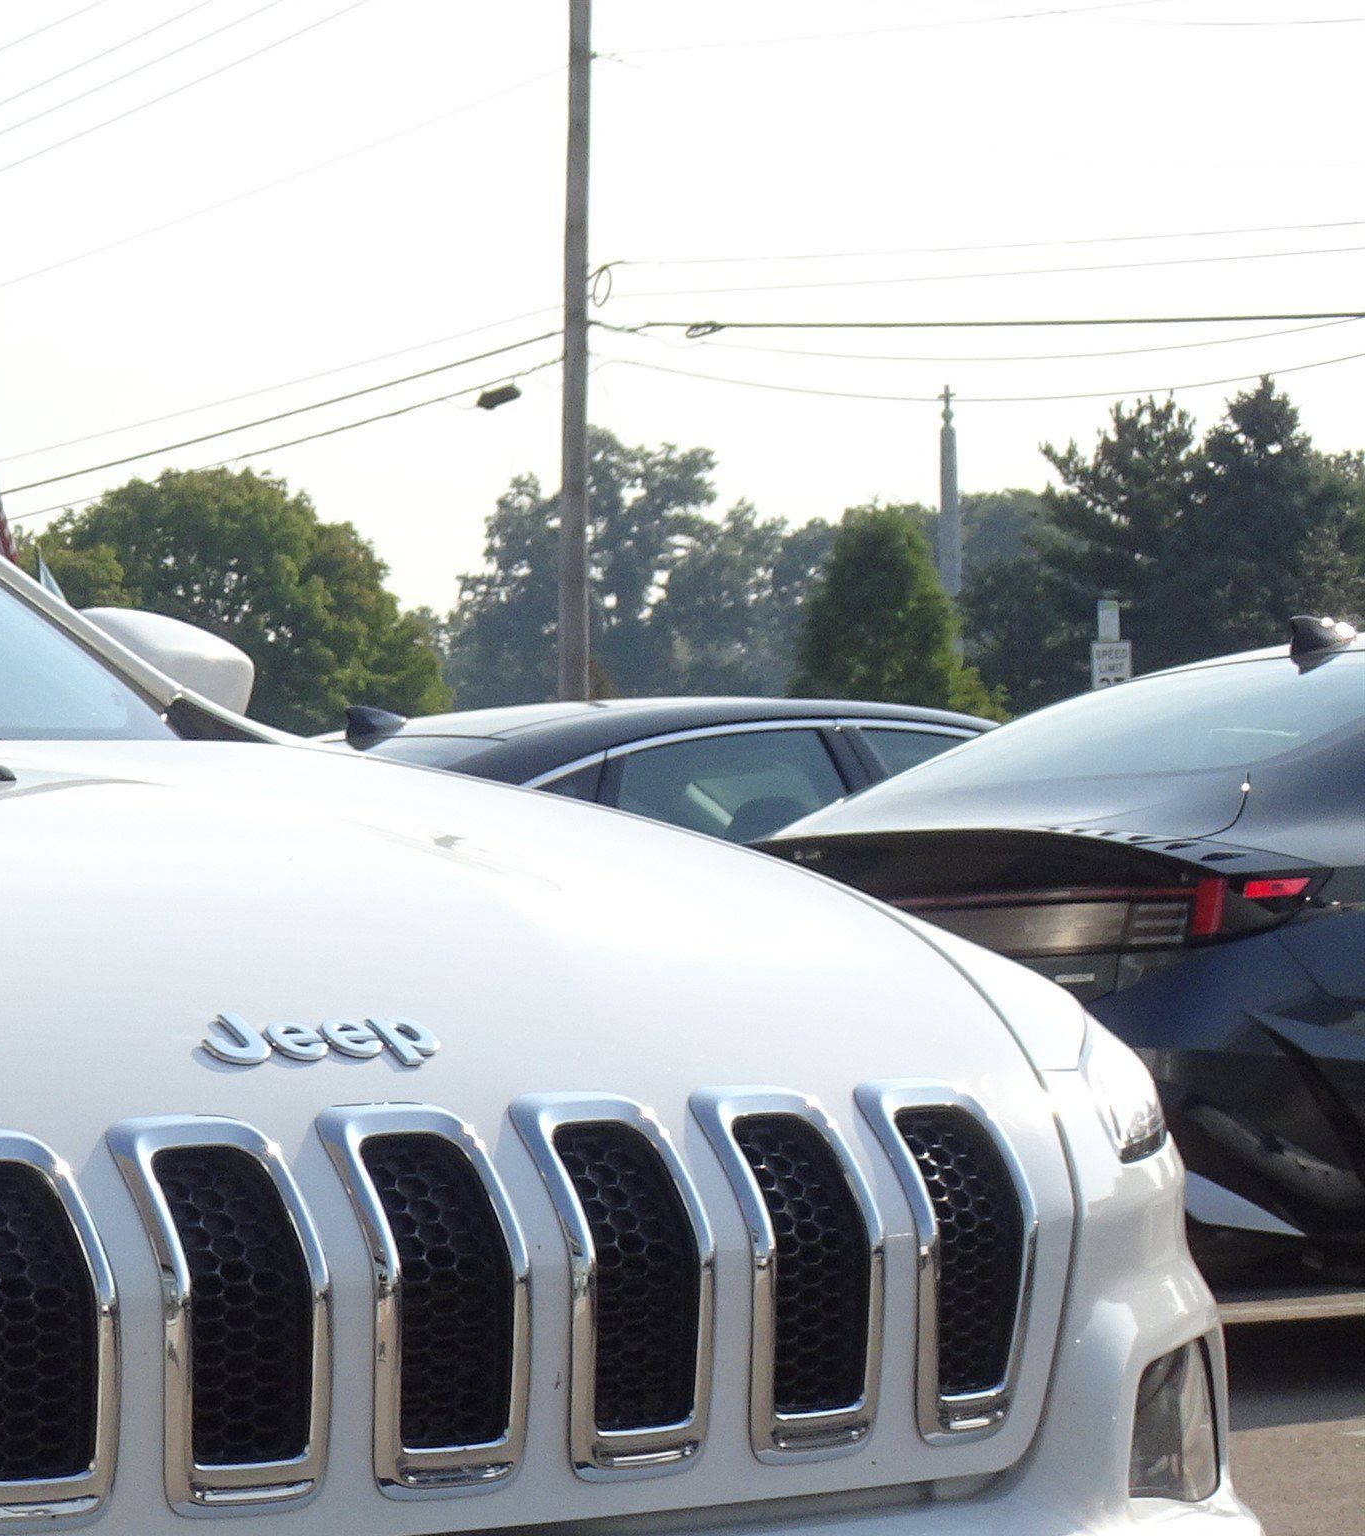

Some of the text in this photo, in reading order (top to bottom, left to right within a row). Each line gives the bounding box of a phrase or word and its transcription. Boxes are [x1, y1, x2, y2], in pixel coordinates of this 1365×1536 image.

[1095, 649, 1127, 660] SPEED
[1099, 663, 1125, 673] LIMIT
[199, 1012, 442, 1066] Jeep
